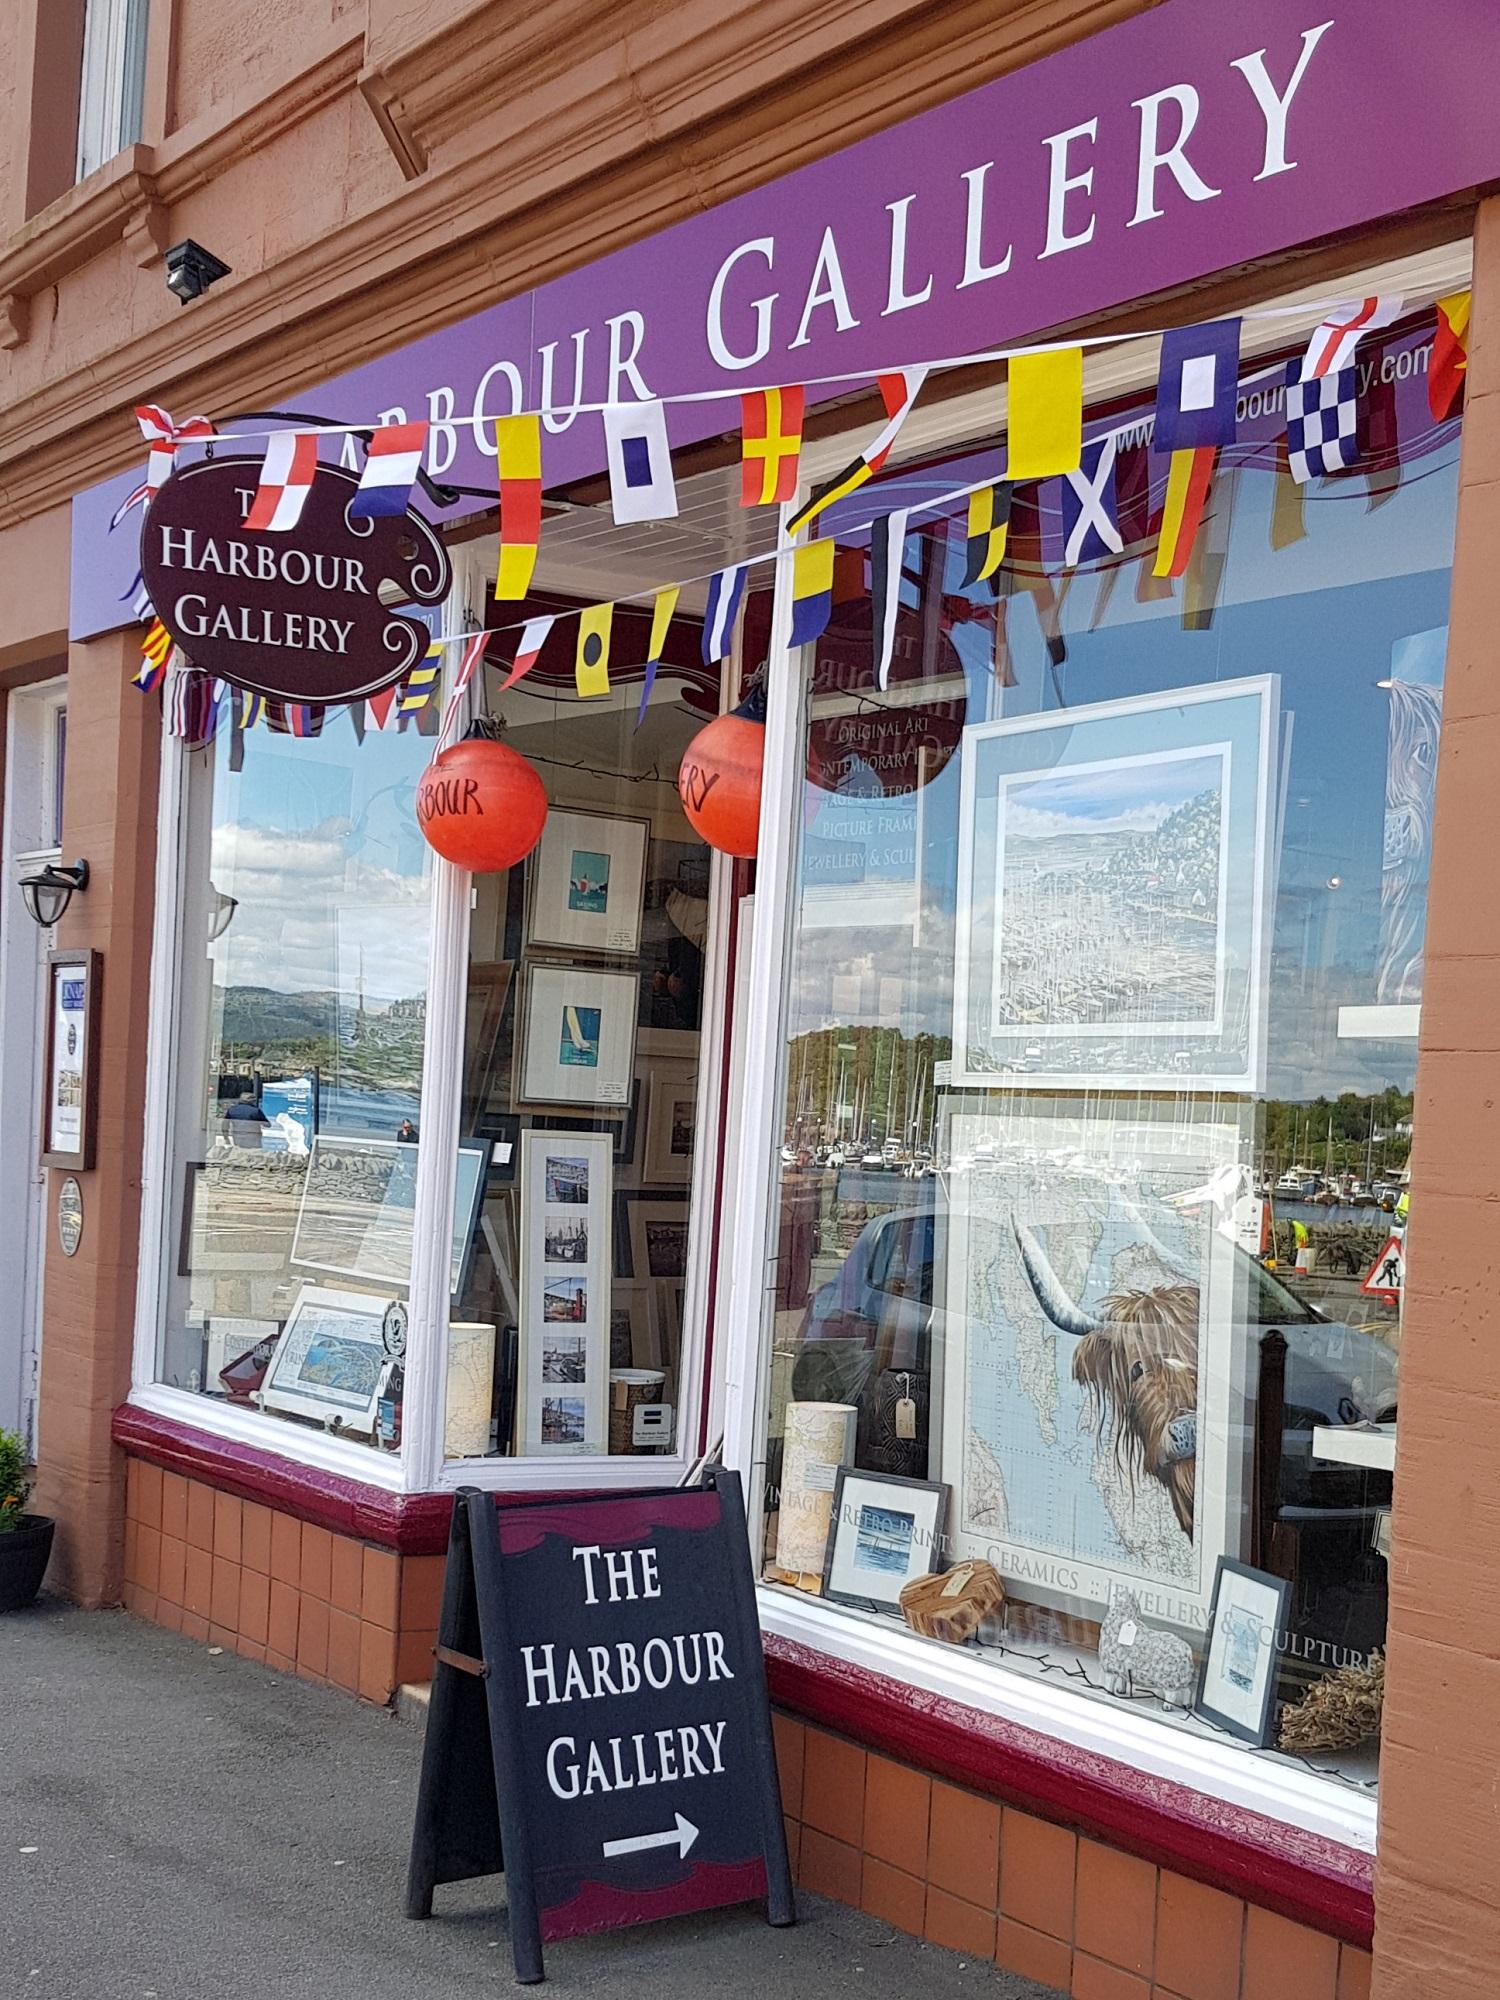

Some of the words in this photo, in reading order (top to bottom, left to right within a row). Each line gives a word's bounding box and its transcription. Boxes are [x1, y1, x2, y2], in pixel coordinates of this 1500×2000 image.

[705, 19, 1335, 371] GALLERY
[159, 525, 371, 595] HARBOUR
[174, 593, 355, 654] GALLERY
[838, 720, 900, 744] ORIGINAL
[903, 716, 928, 736] ART
[820, 752, 910, 778] ONTEMPORARY
[823, 819, 873, 838] PICTURE
[878, 816, 916, 834] FRAM
[869, 848, 881, 867] &
[572, 1544, 661, 1606] THE
[761, 1483, 823, 1517] VINTAGE
[829, 1500, 839, 1521] &
[843, 1503, 894, 1534] RETRO
[899, 1517, 954, 1555] PRINTS
[986, 1545, 1079, 1591] CERAMICS
[1106, 1578, 1216, 1632] JEWELLERY
[1221, 1611, 1238, 1639] &
[520, 1631, 734, 1708] HARBOUR
[546, 1721, 727, 1800] GALLERY
